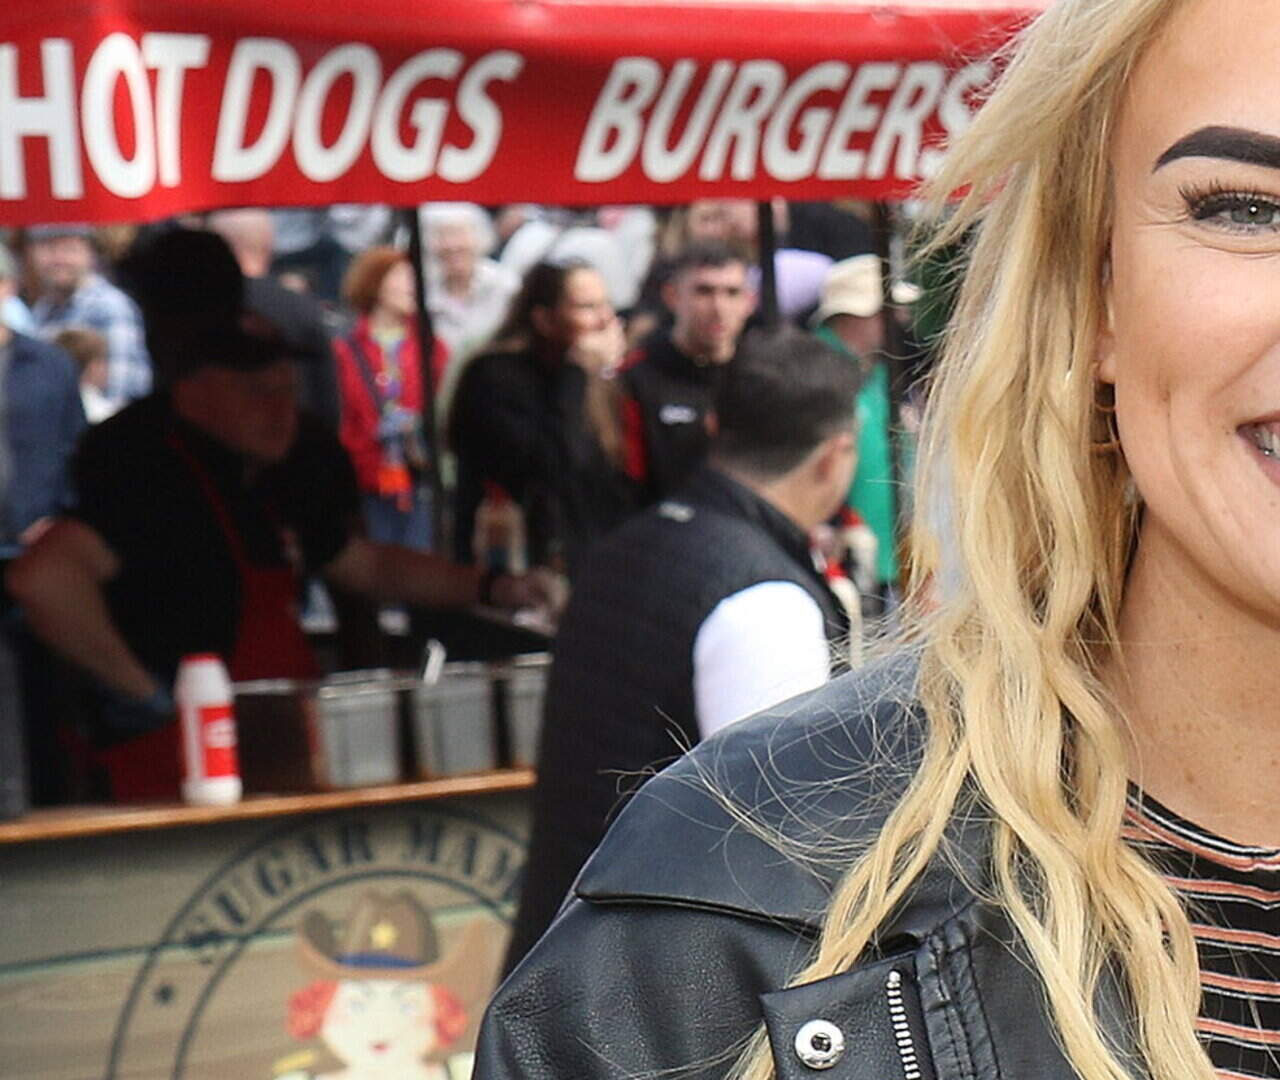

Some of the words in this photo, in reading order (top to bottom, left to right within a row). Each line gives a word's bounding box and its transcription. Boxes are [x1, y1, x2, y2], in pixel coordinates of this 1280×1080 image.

[0, 32, 212, 201] HOT
[211, 37, 525, 184] DOGS
[573, 57, 995, 184] BURGERS
[184, 818, 375, 965] SUGAR
